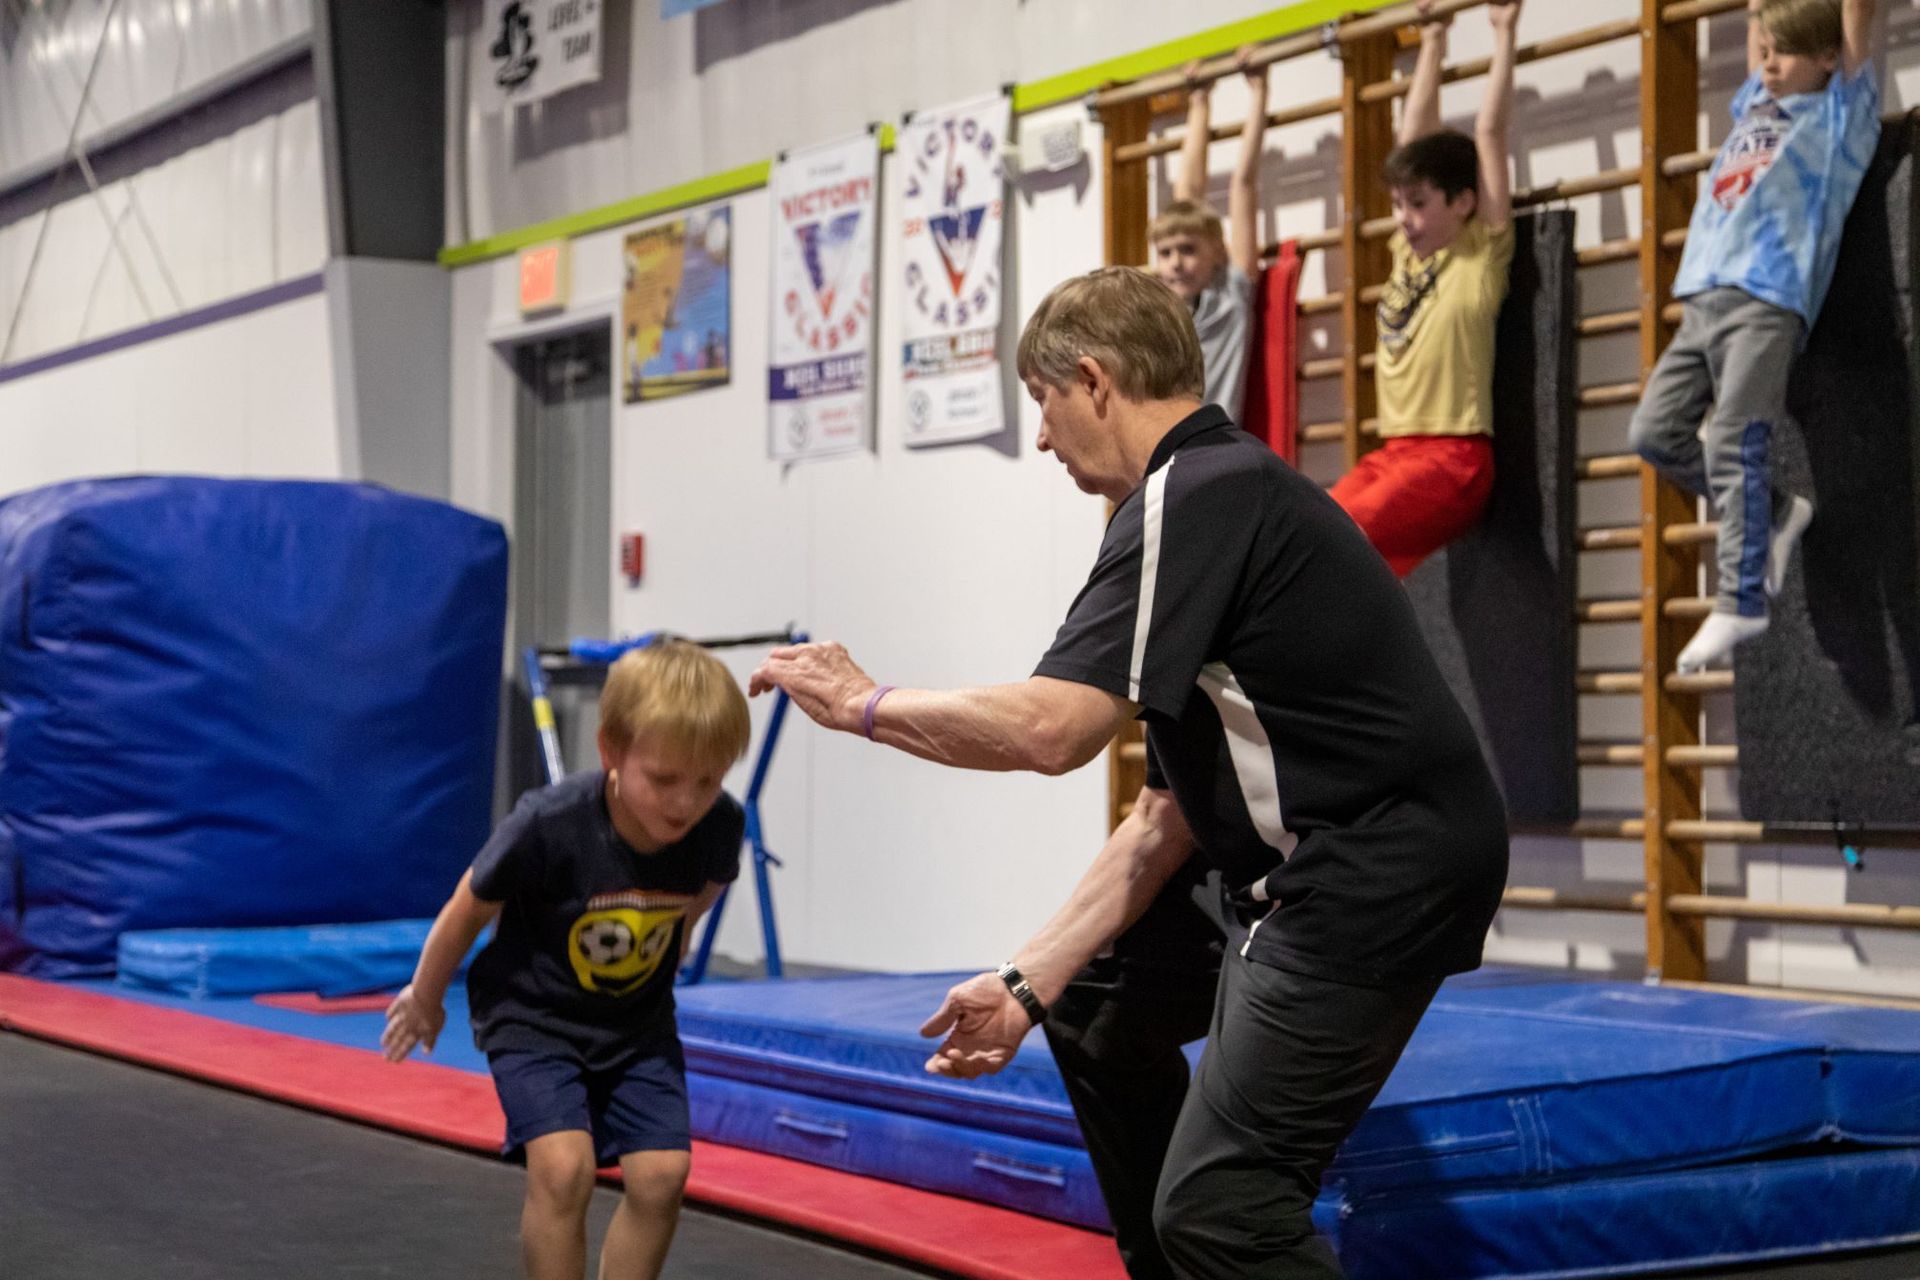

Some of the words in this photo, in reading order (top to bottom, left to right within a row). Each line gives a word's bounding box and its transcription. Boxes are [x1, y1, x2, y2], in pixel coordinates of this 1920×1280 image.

[1727, 136, 1778, 154] TATE
[780, 177, 871, 223] VICTORY
[904, 260, 998, 326] CLASSI
